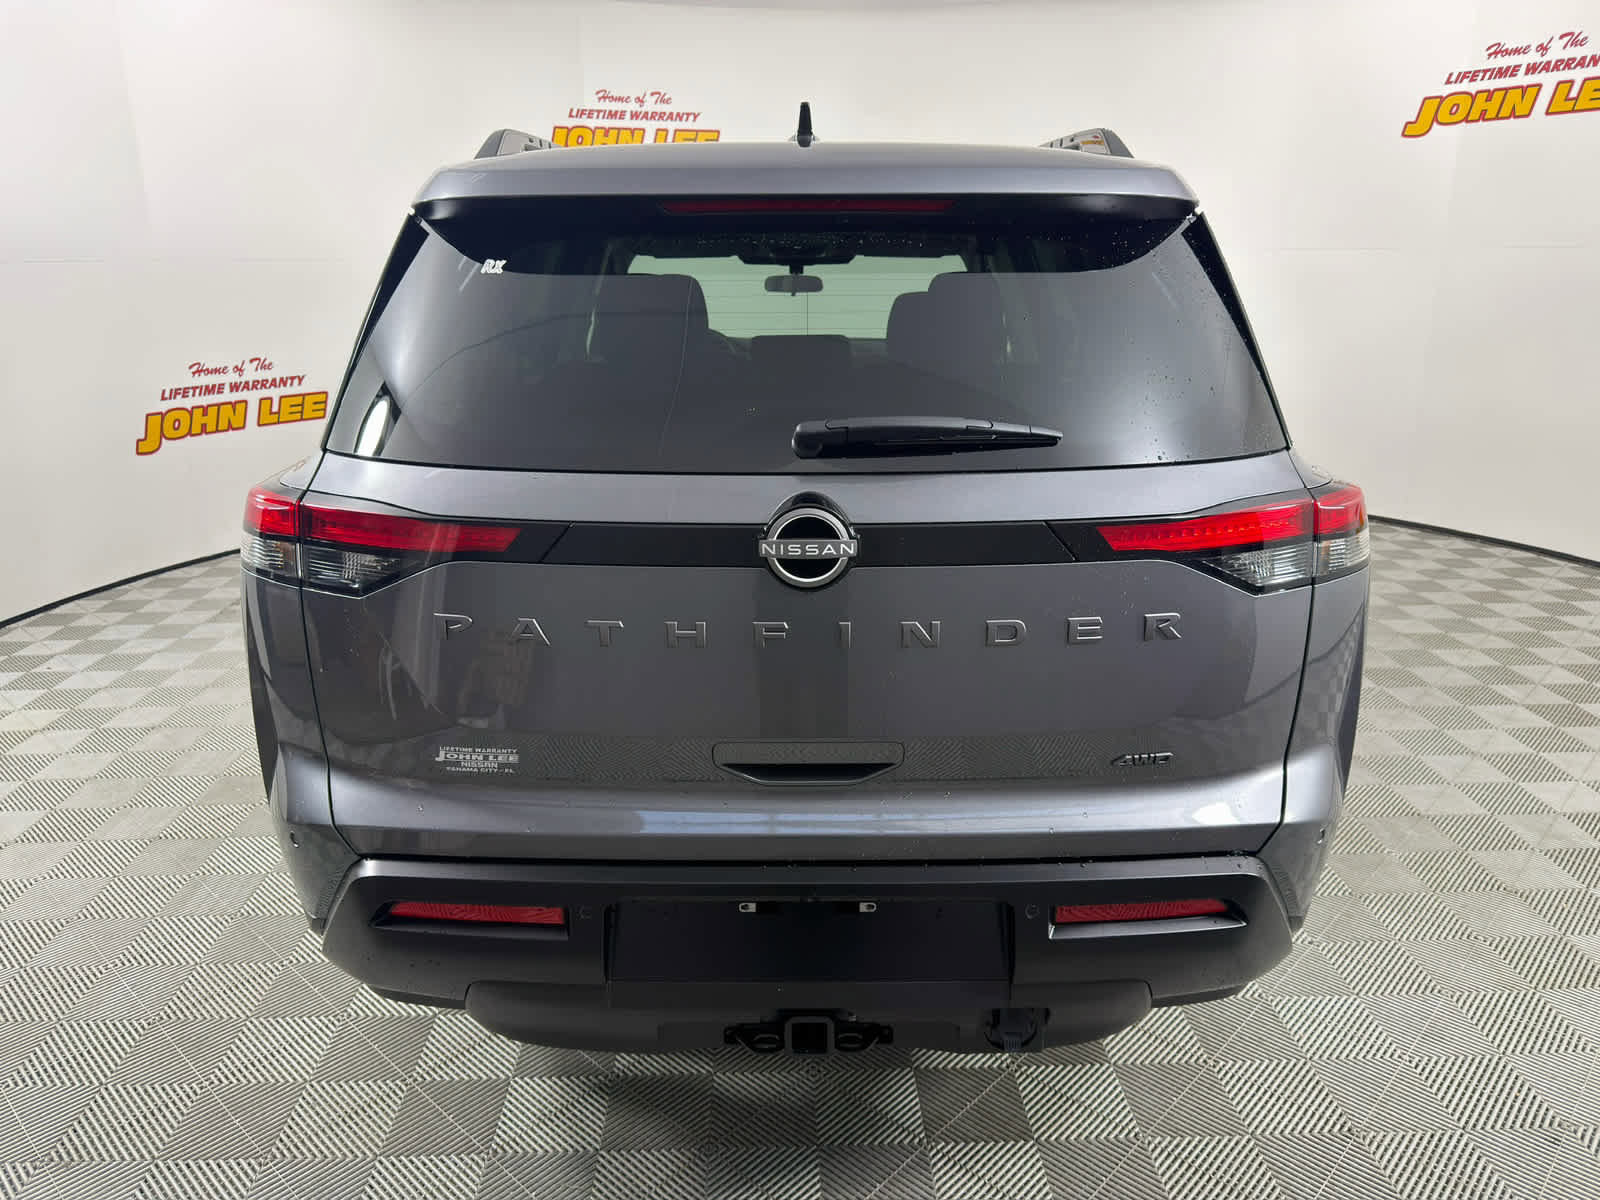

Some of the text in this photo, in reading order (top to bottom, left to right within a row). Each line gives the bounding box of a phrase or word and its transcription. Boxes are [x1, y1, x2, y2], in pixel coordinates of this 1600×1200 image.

[1486, 31, 1589, 60] Home of The
[1444, 53, 1600, 85] LIFETIME WARRAN
[595, 89, 673, 107] Home of The
[1401, 76, 1600, 138] JOHN LE
[568, 108, 701, 122] LIFETIME WARRANTY
[552, 125, 646, 147] JOHN
[188, 357, 274, 377] Home of The
[160, 375, 306, 401] LIFETIME WARRANTY
[136, 391, 329, 456] JOHN LEE
[761, 543, 855, 556] NISSAN
[433, 611, 1183, 649] PATHFINDER
[435, 750, 520, 763] JOHN LEE
